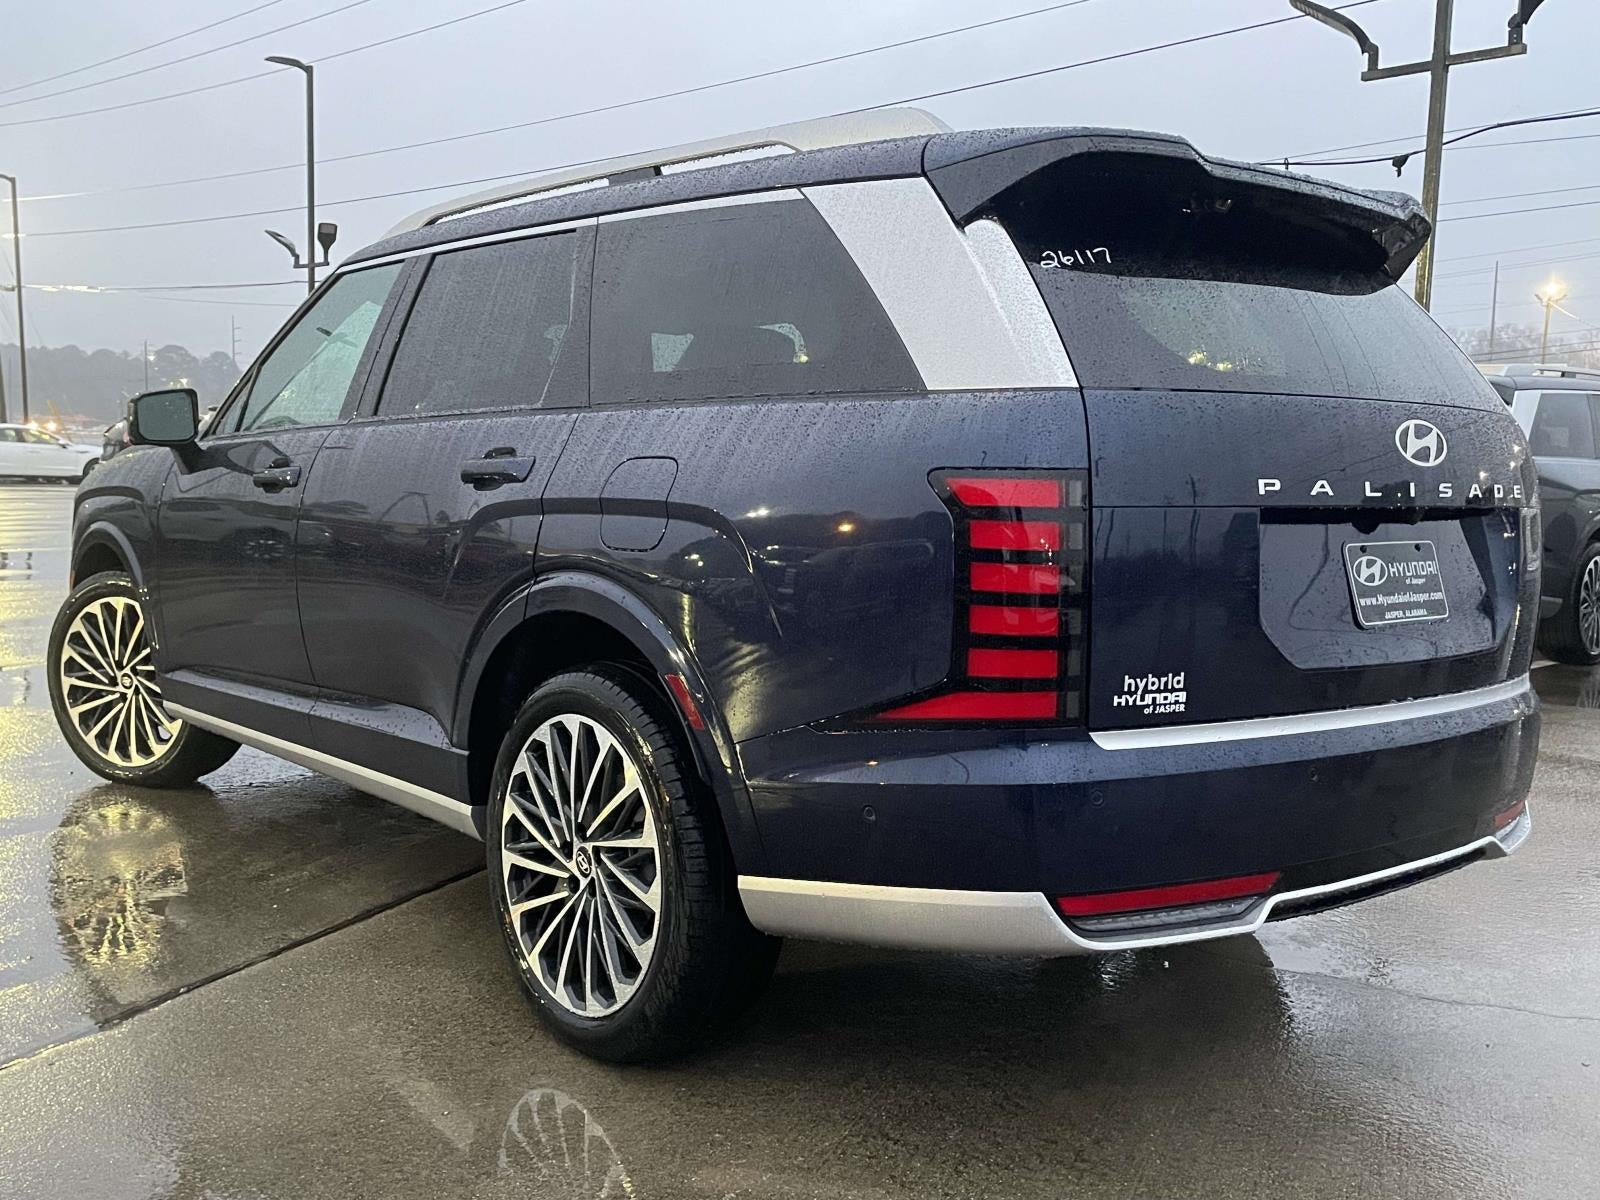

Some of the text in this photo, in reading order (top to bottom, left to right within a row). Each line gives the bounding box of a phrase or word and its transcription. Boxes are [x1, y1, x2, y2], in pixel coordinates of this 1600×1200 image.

[1040, 247, 1112, 268] 26117
[1257, 478, 1522, 499] PALISADE
[1388, 560, 1438, 577] HYUNDAI
[1405, 608, 1427, 616] ALABAMA
[1123, 671, 1185, 695] hybrid
[1113, 691, 1187, 706] HYUNDAI
[1143, 704, 1186, 714] of JASPER
